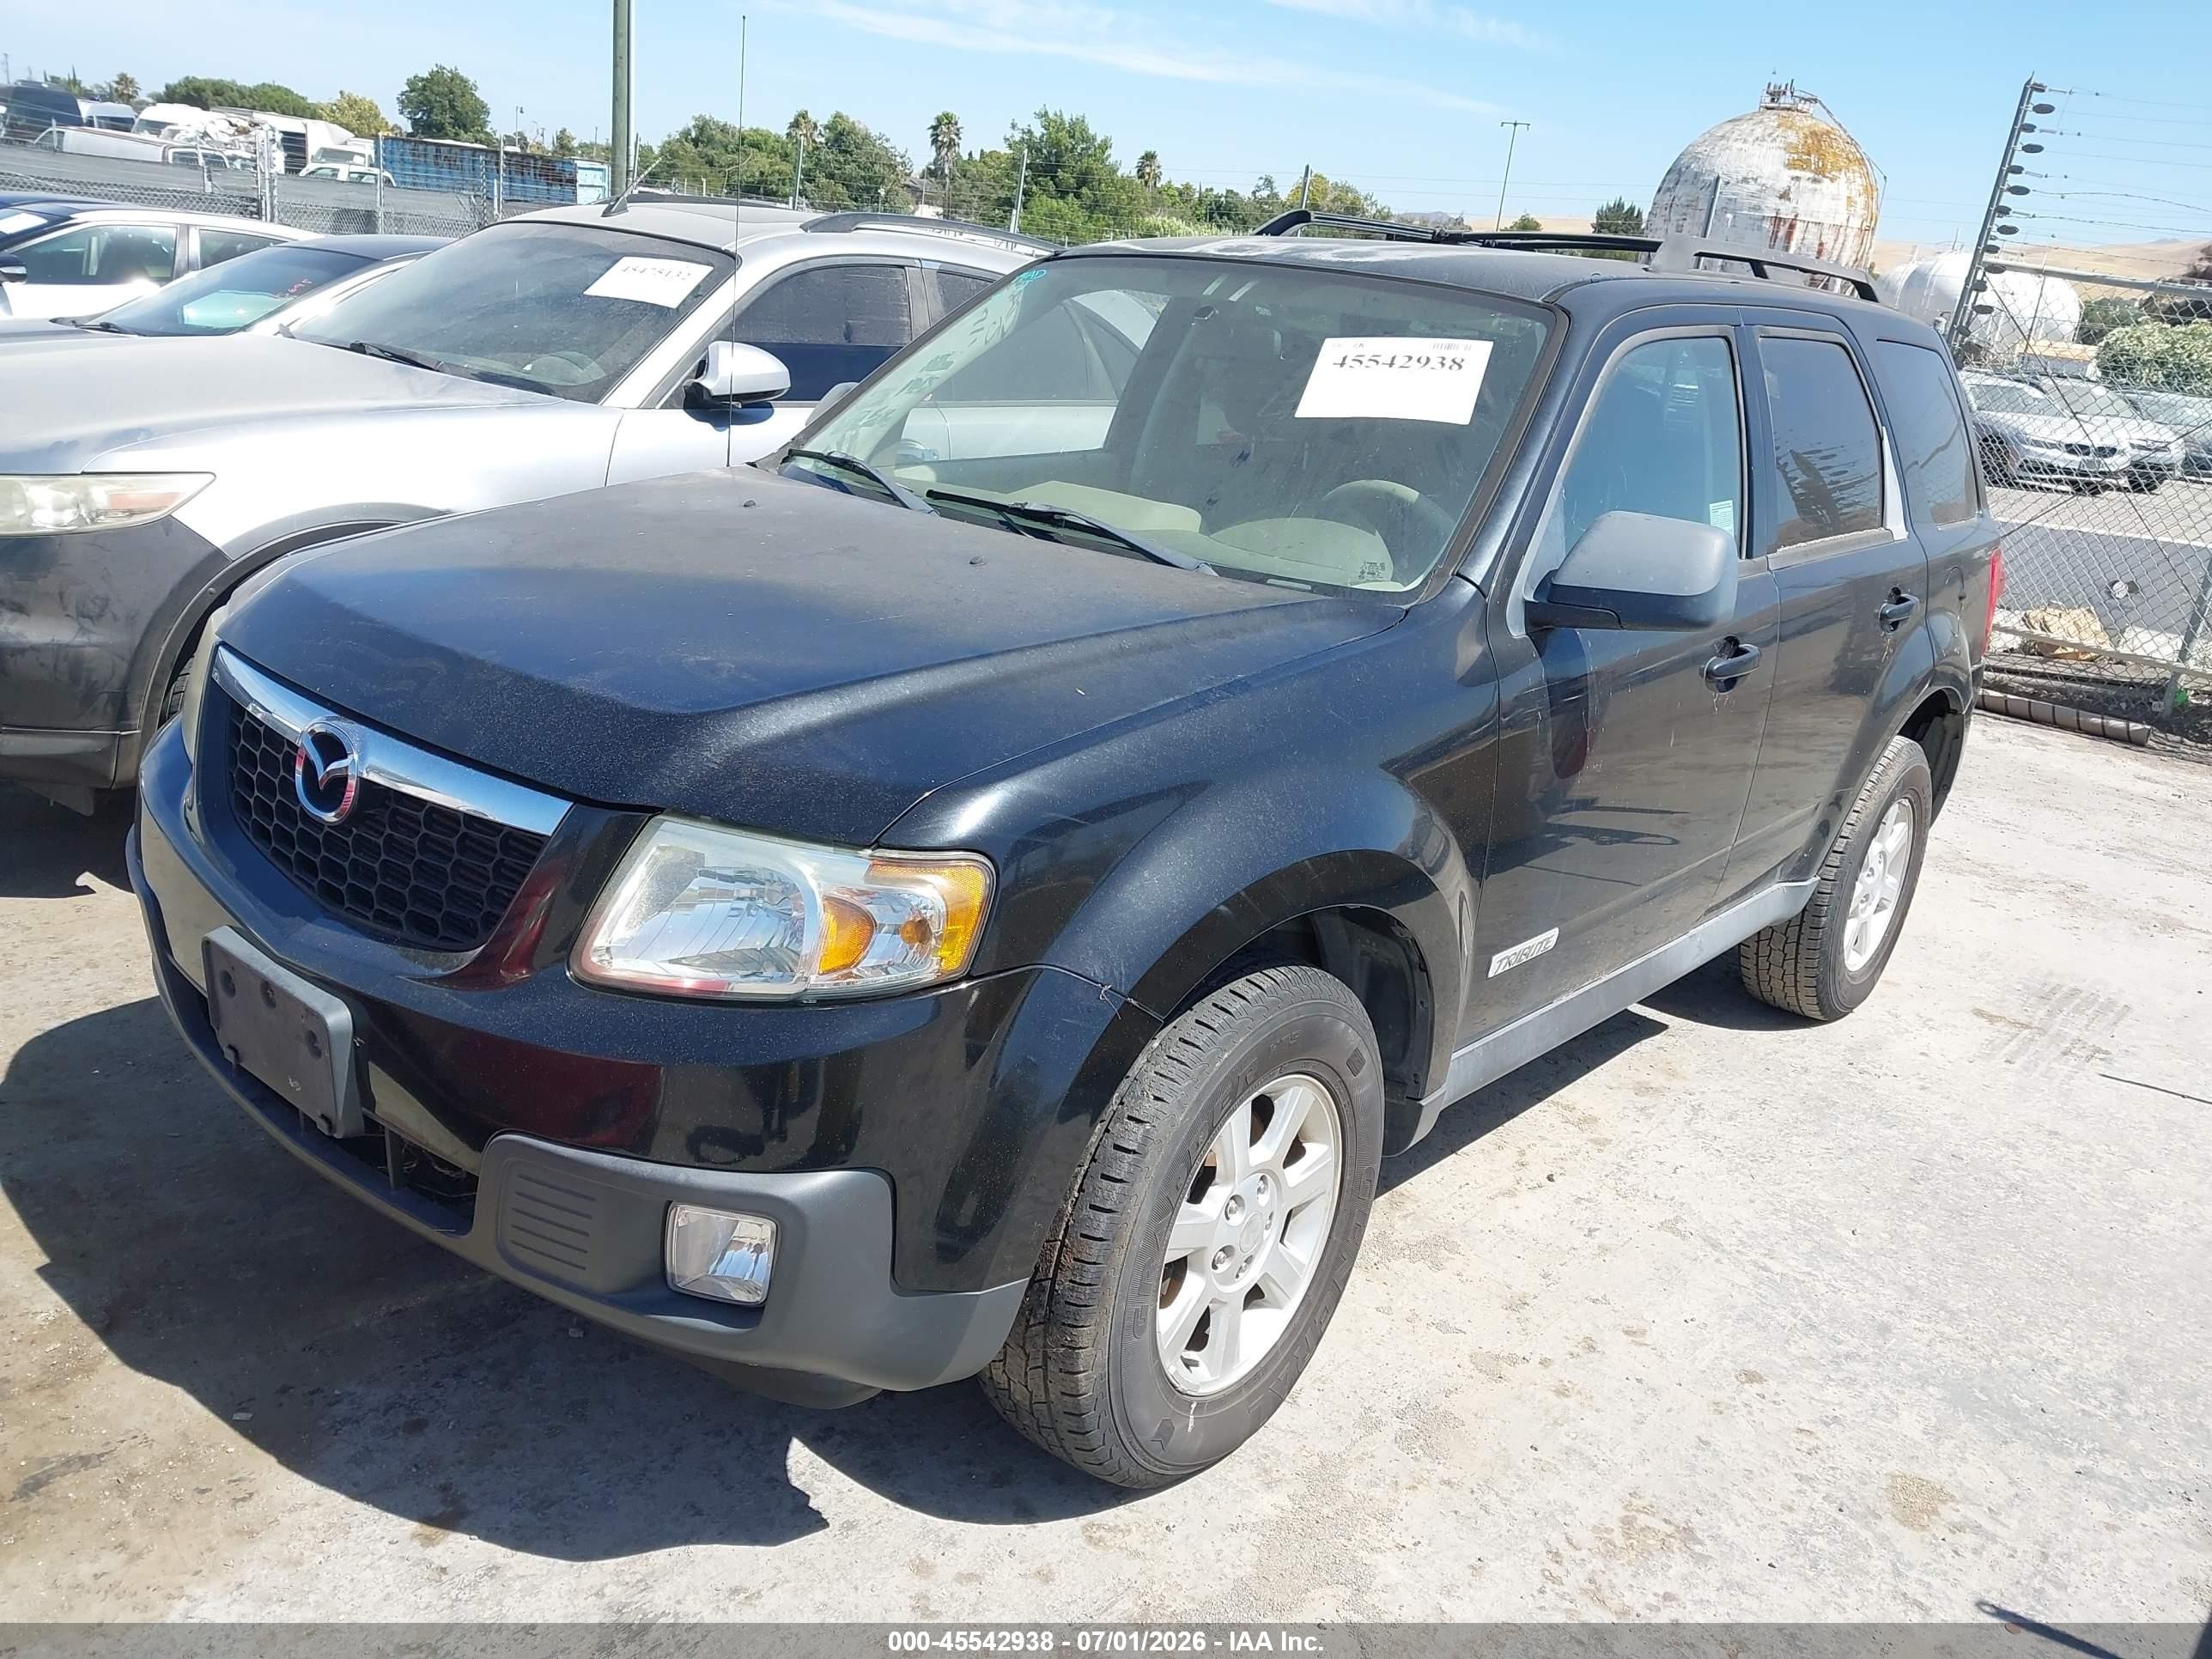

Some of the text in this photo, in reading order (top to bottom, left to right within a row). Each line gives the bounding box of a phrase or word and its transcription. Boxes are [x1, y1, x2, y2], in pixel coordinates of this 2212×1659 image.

[1332, 354, 1466, 372] 45542938
[1494, 933, 1555, 975] TRIBUTE
[1248, 1164, 1376, 1431] GENERAL
